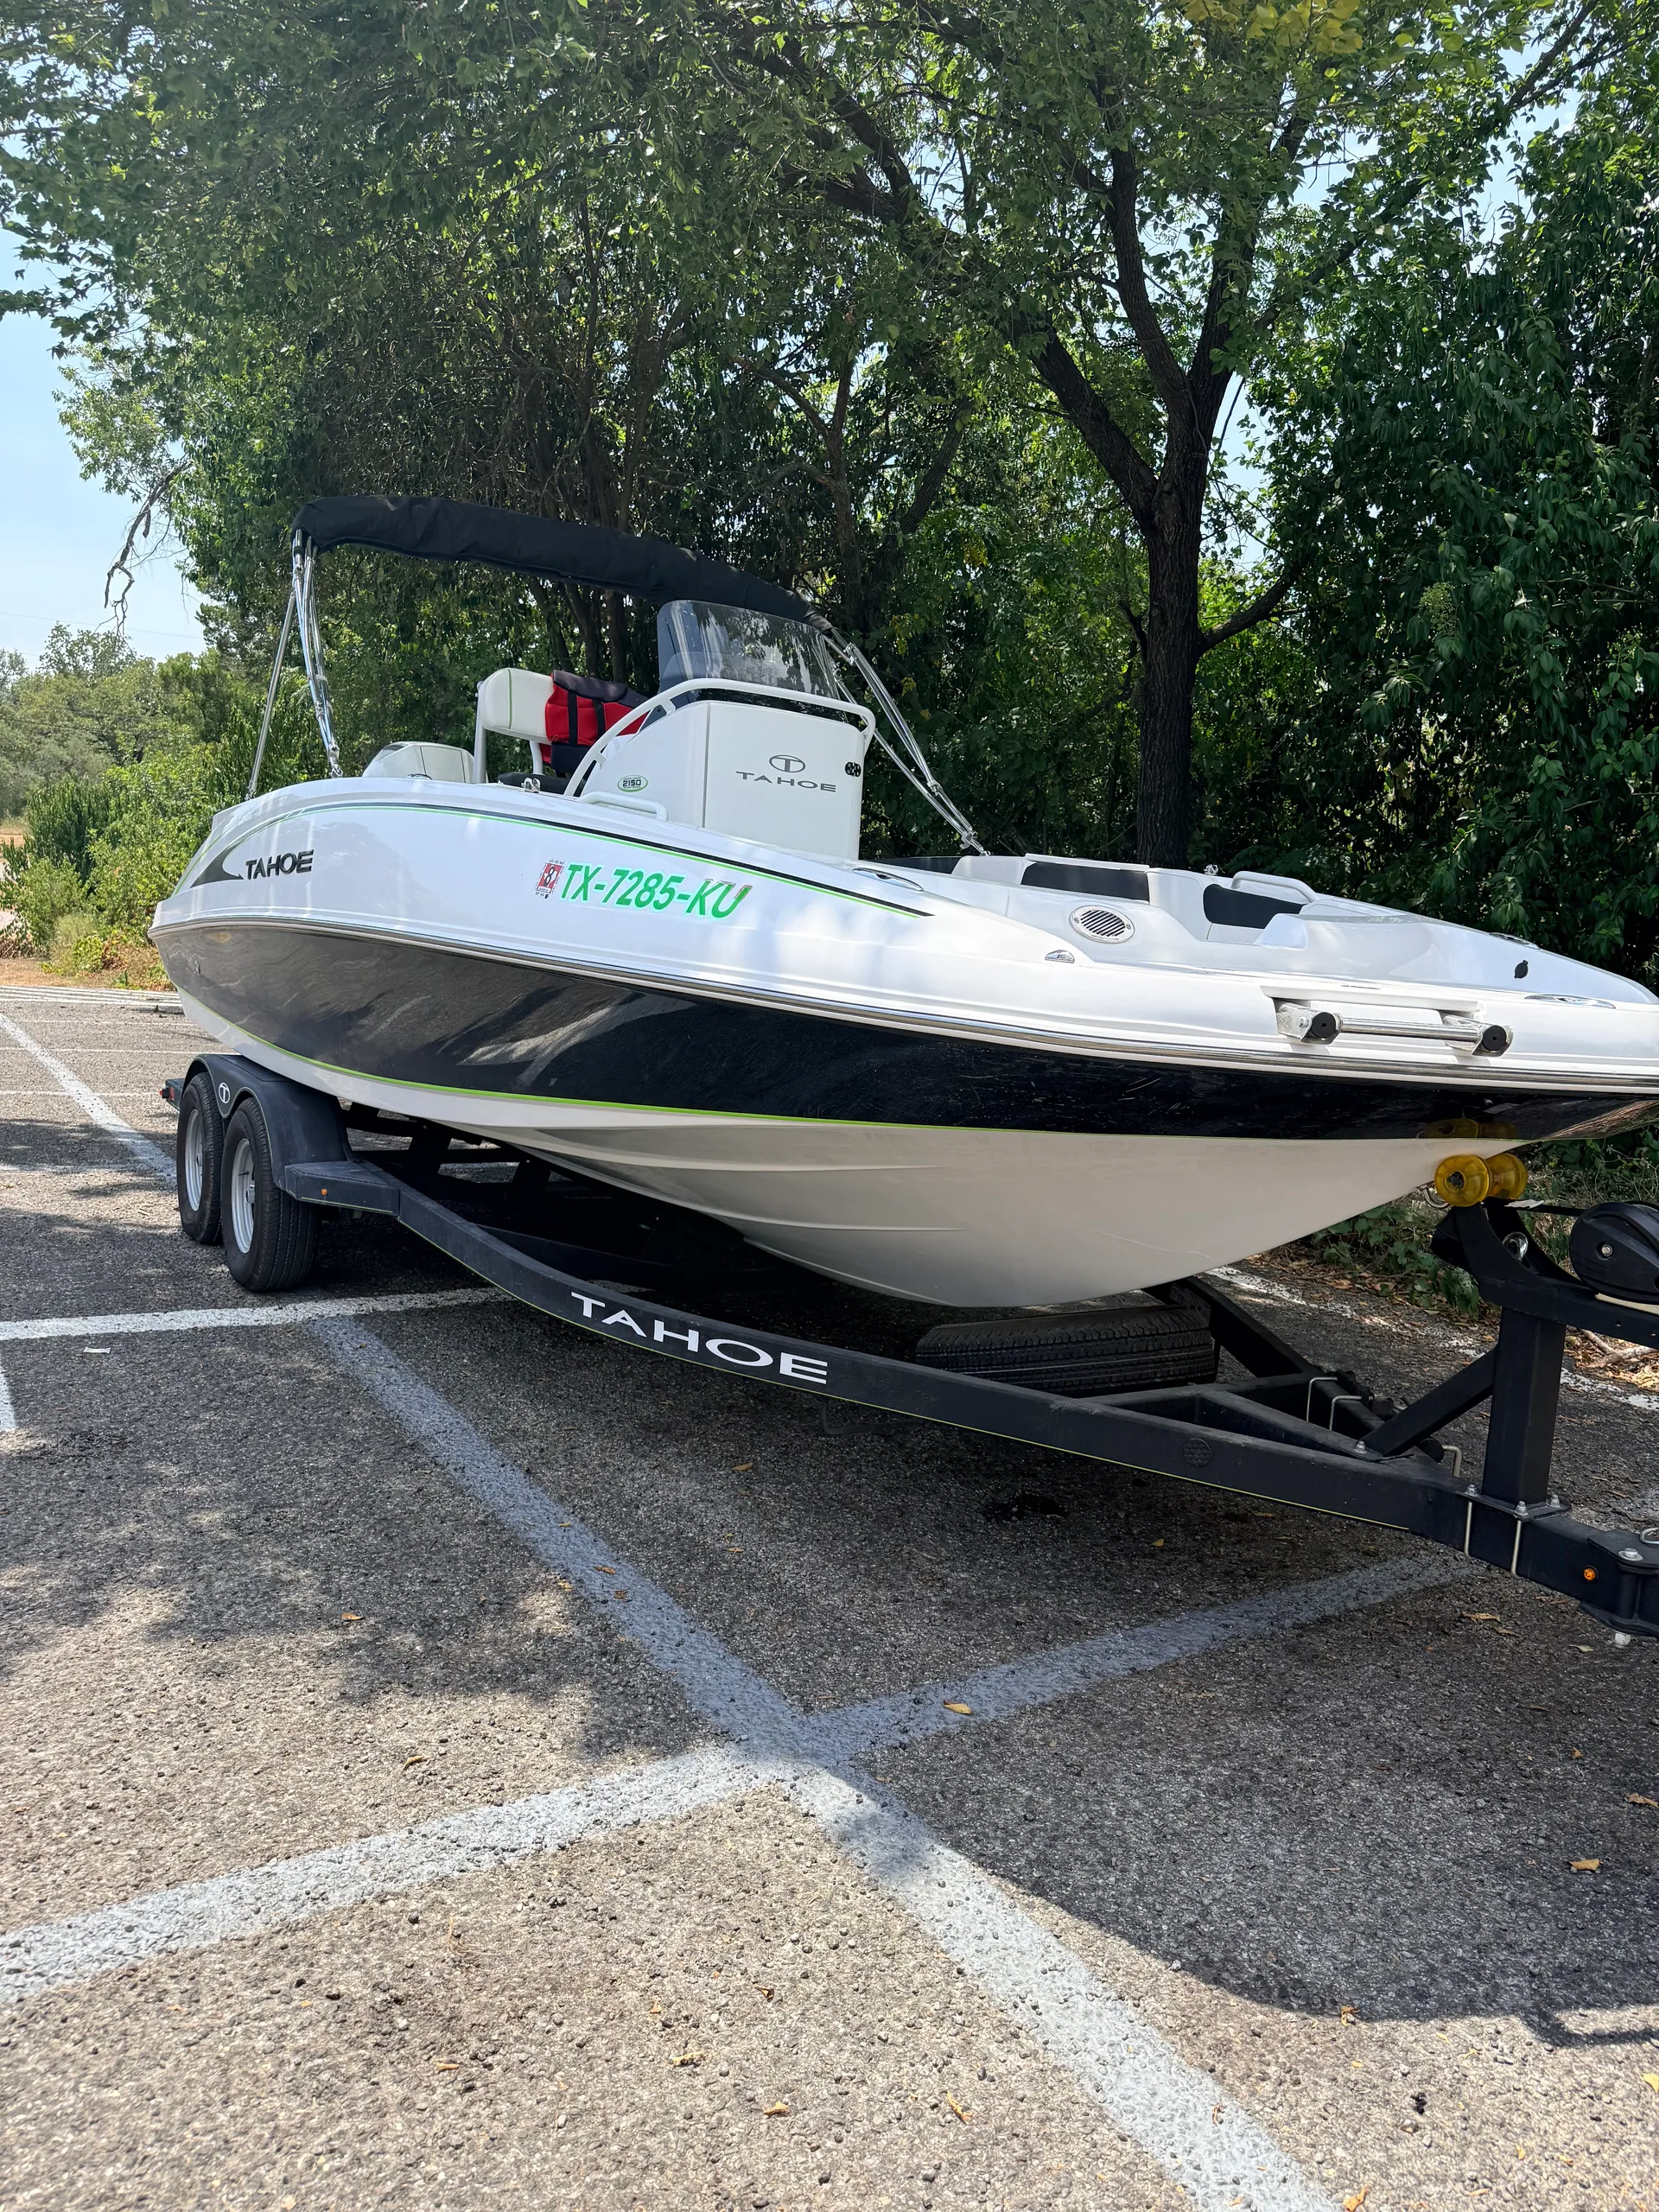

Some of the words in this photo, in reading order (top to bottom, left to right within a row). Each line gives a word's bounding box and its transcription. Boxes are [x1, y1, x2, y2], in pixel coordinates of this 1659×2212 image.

[736, 771, 836, 792] TAHOE
[245, 849, 315, 880] TAHOE
[561, 864, 753, 918] TX-7285-KU
[571, 1292, 828, 1384] TAHOE
